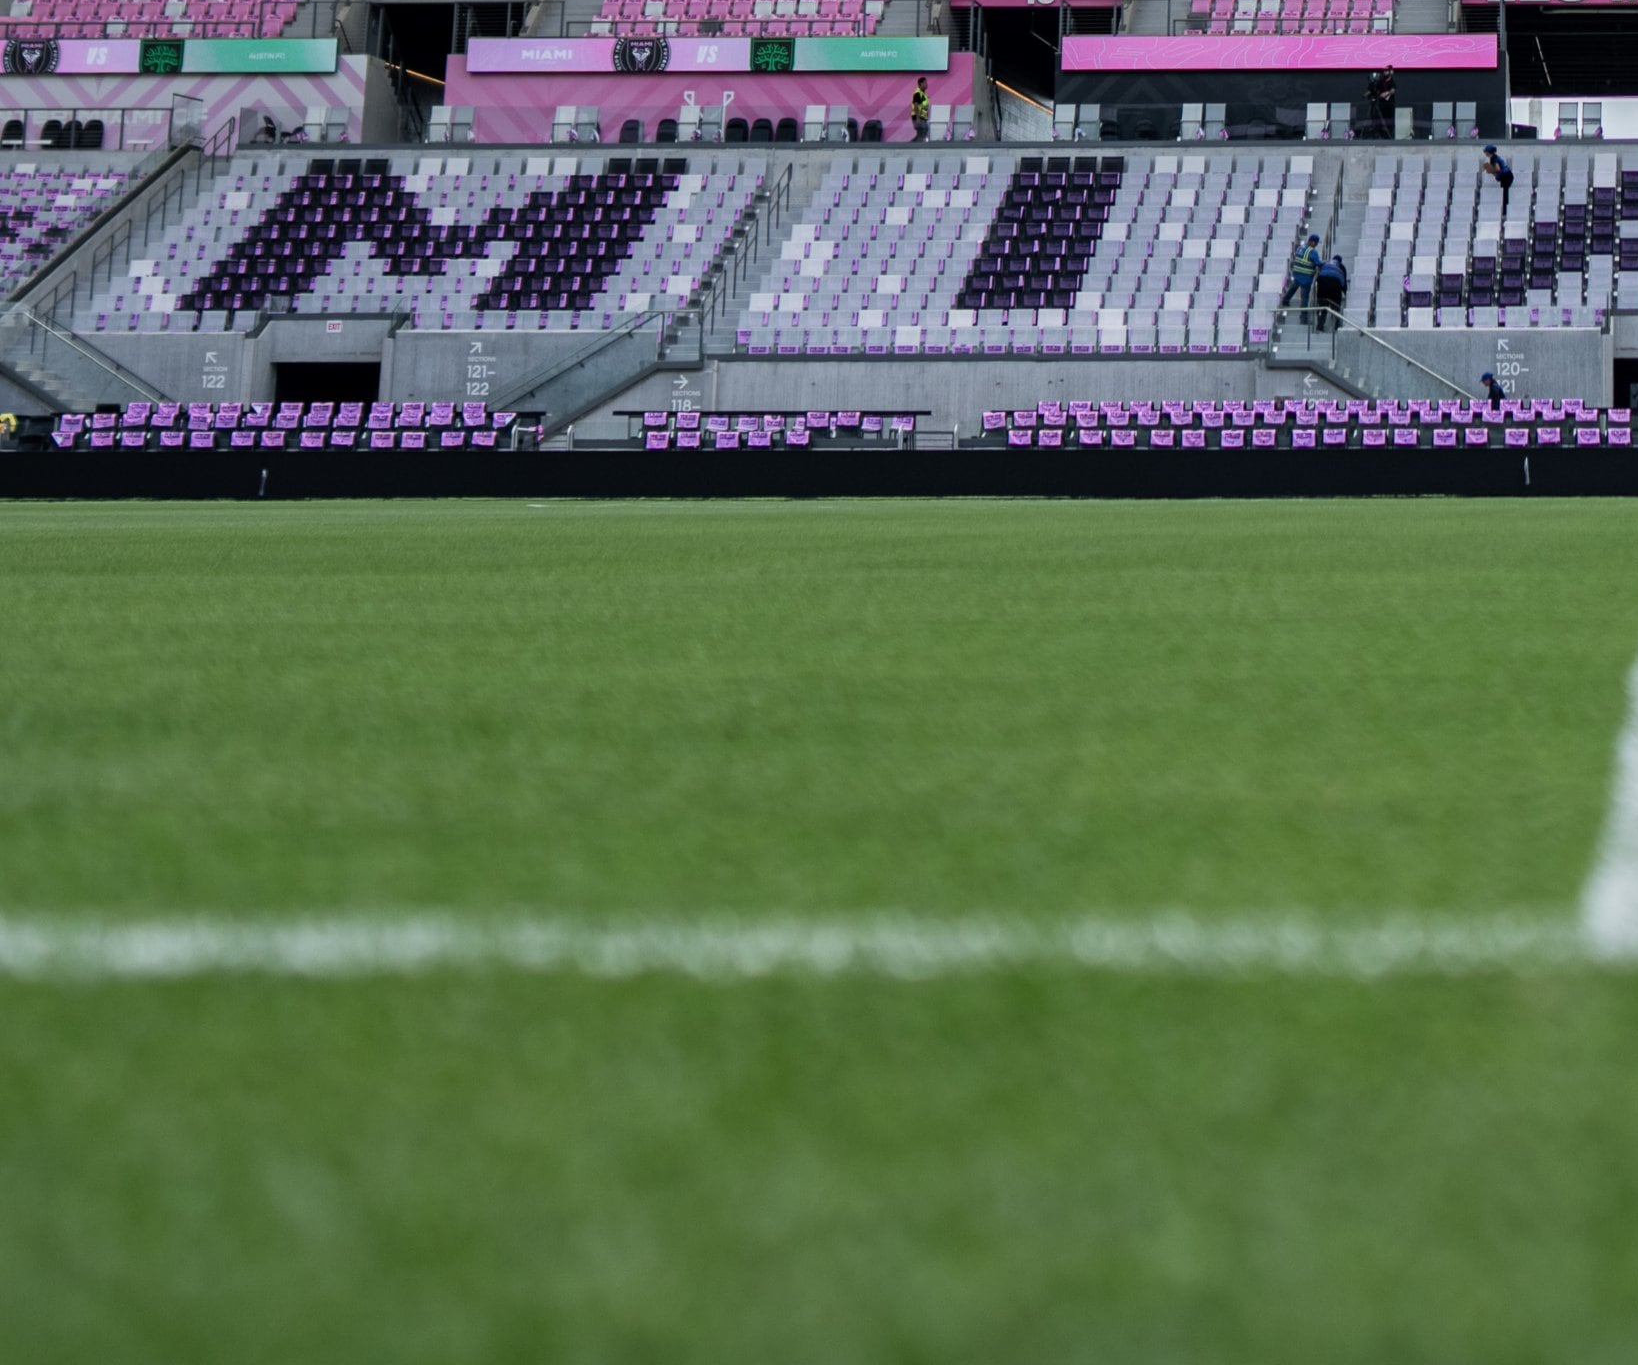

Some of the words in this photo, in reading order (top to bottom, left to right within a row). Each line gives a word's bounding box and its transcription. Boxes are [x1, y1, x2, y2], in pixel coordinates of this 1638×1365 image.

[86, 46, 108, 66] VS
[520, 48, 573, 60] MIAMI
[696, 45, 719, 65] VS
[860, 50, 885, 58] AUSTIN
[328, 322, 342, 331] EXIT
[202, 375, 225, 388] 122
[466, 382, 489, 395] 122
